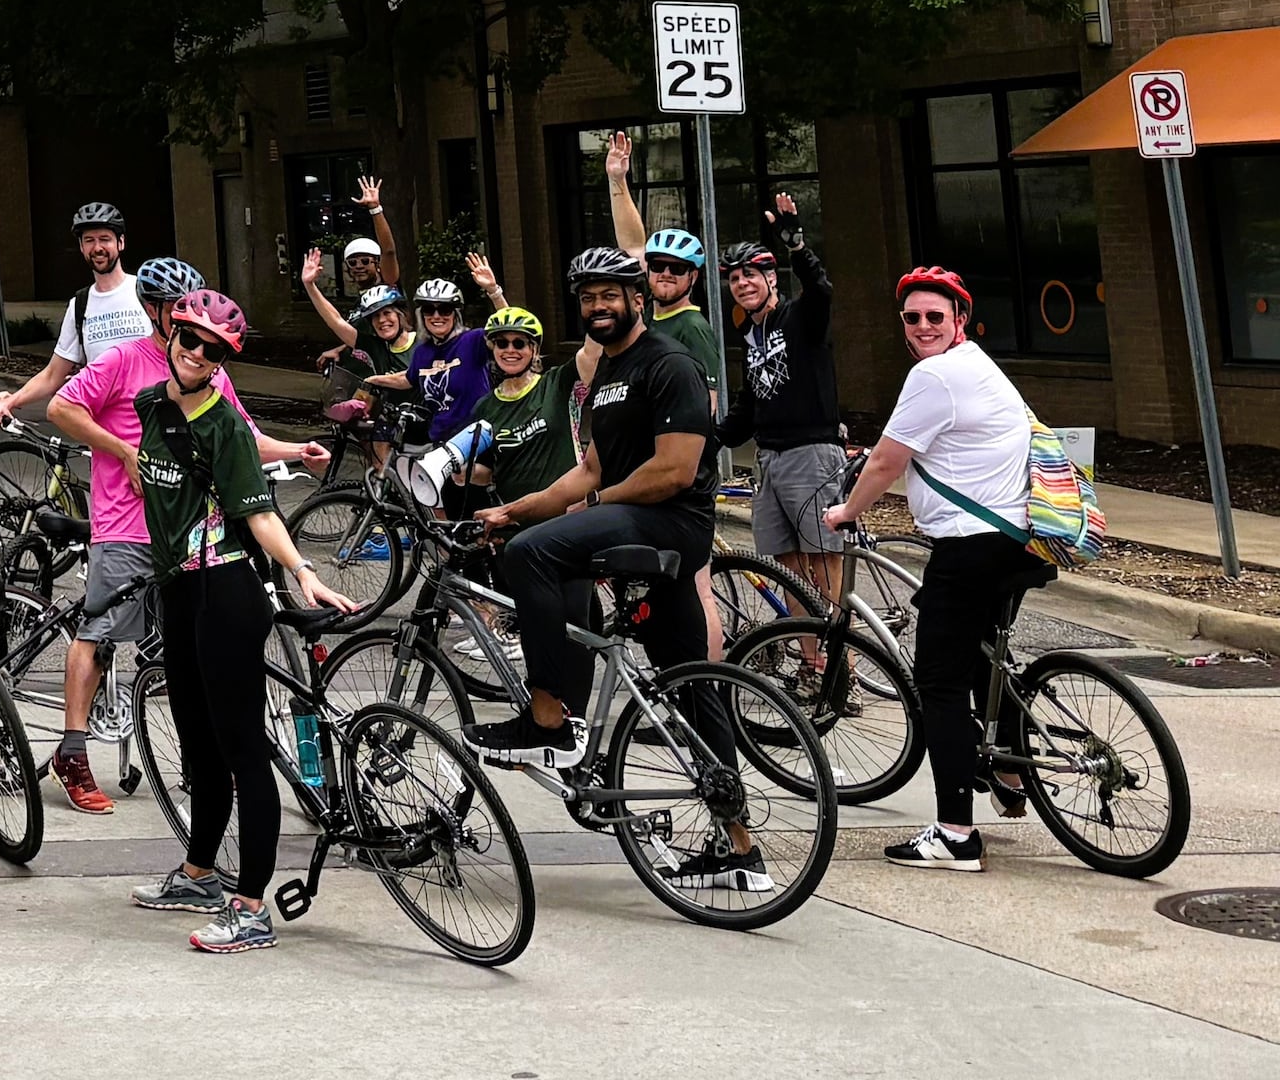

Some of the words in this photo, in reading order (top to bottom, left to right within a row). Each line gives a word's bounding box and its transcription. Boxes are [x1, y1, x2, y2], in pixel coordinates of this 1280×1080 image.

[663, 16, 731, 33] SPEED
[671, 38, 725, 56] LIMIT
[666, 60, 733, 99] 25
[1145, 126, 1161, 136] ANY
[1166, 124, 1186, 136] TIME
